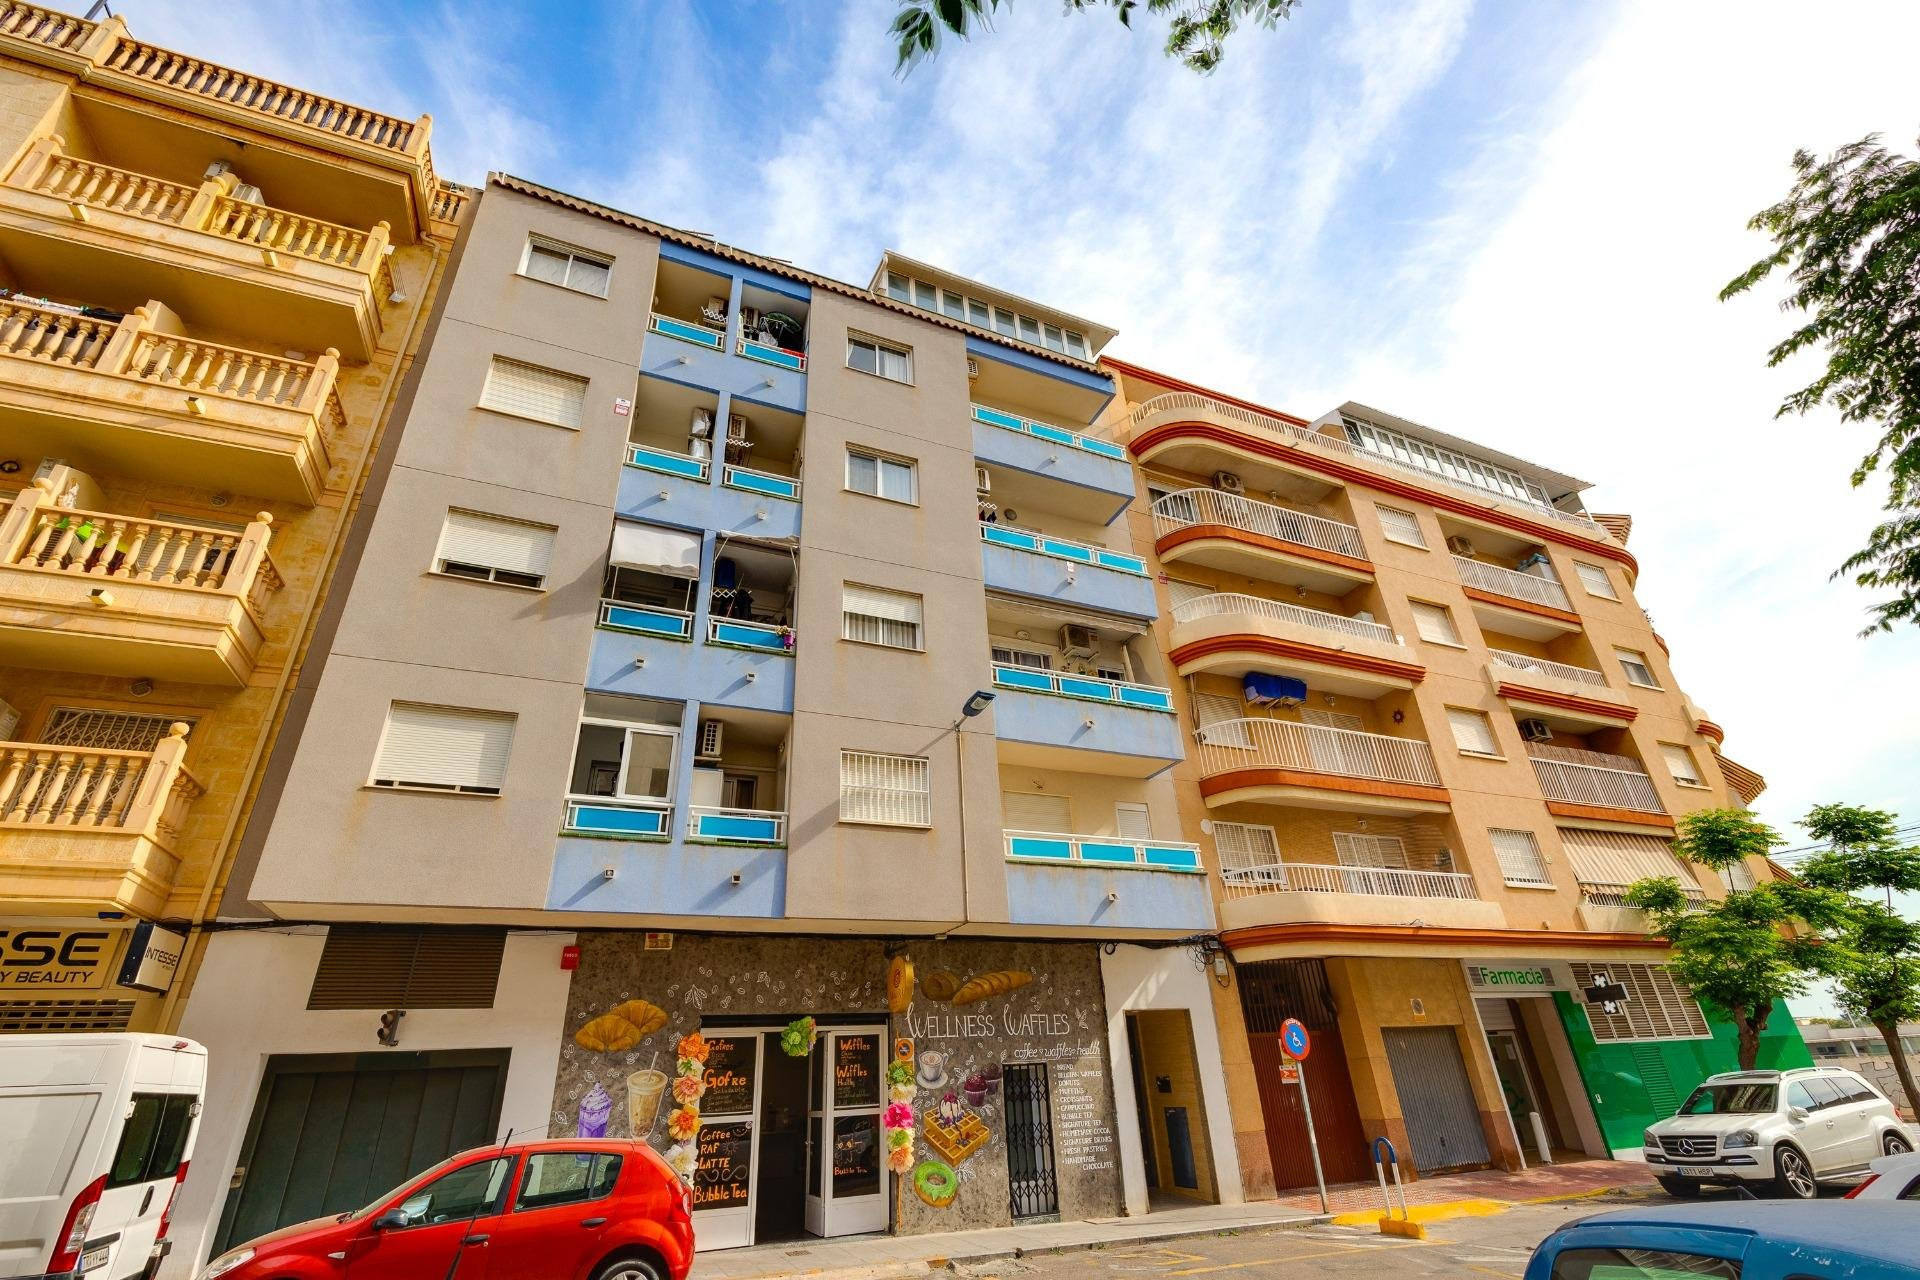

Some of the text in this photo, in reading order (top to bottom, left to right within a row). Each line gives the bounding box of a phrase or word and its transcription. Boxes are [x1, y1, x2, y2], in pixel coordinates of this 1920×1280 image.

[0, 930, 109, 966] SE
[144, 946, 178, 967] INTESSE
[15, 971, 94, 983] BEAUTY
[1479, 967, 1545, 985] Farmacia
[905, 1001, 1070, 1038] WELLNESS WAFFLES
[840, 1038, 871, 1051] Waffles
[1014, 1038, 1101, 1060] coffee waffles health
[836, 1064, 868, 1078] Waffles
[1060, 1104, 1095, 1112] CAPPUCCINO
[1062, 1120, 1091, 1129] SIGNATURE
[701, 1129, 731, 1142] Coffee
[1062, 1129, 1093, 1137] HOMEMADE
[1063, 1138, 1093, 1146] SIGNATURE
[701, 1143, 720, 1155] RAF
[1064, 1145, 1108, 1155] FRESH PASTRIES
[699, 1158, 731, 1169] LATTE
[1064, 1156, 1096, 1165] HANDMADE
[1082, 1162, 1114, 1170] CHOCOLATE
[694, 1183, 748, 1204] Bubble Tea
